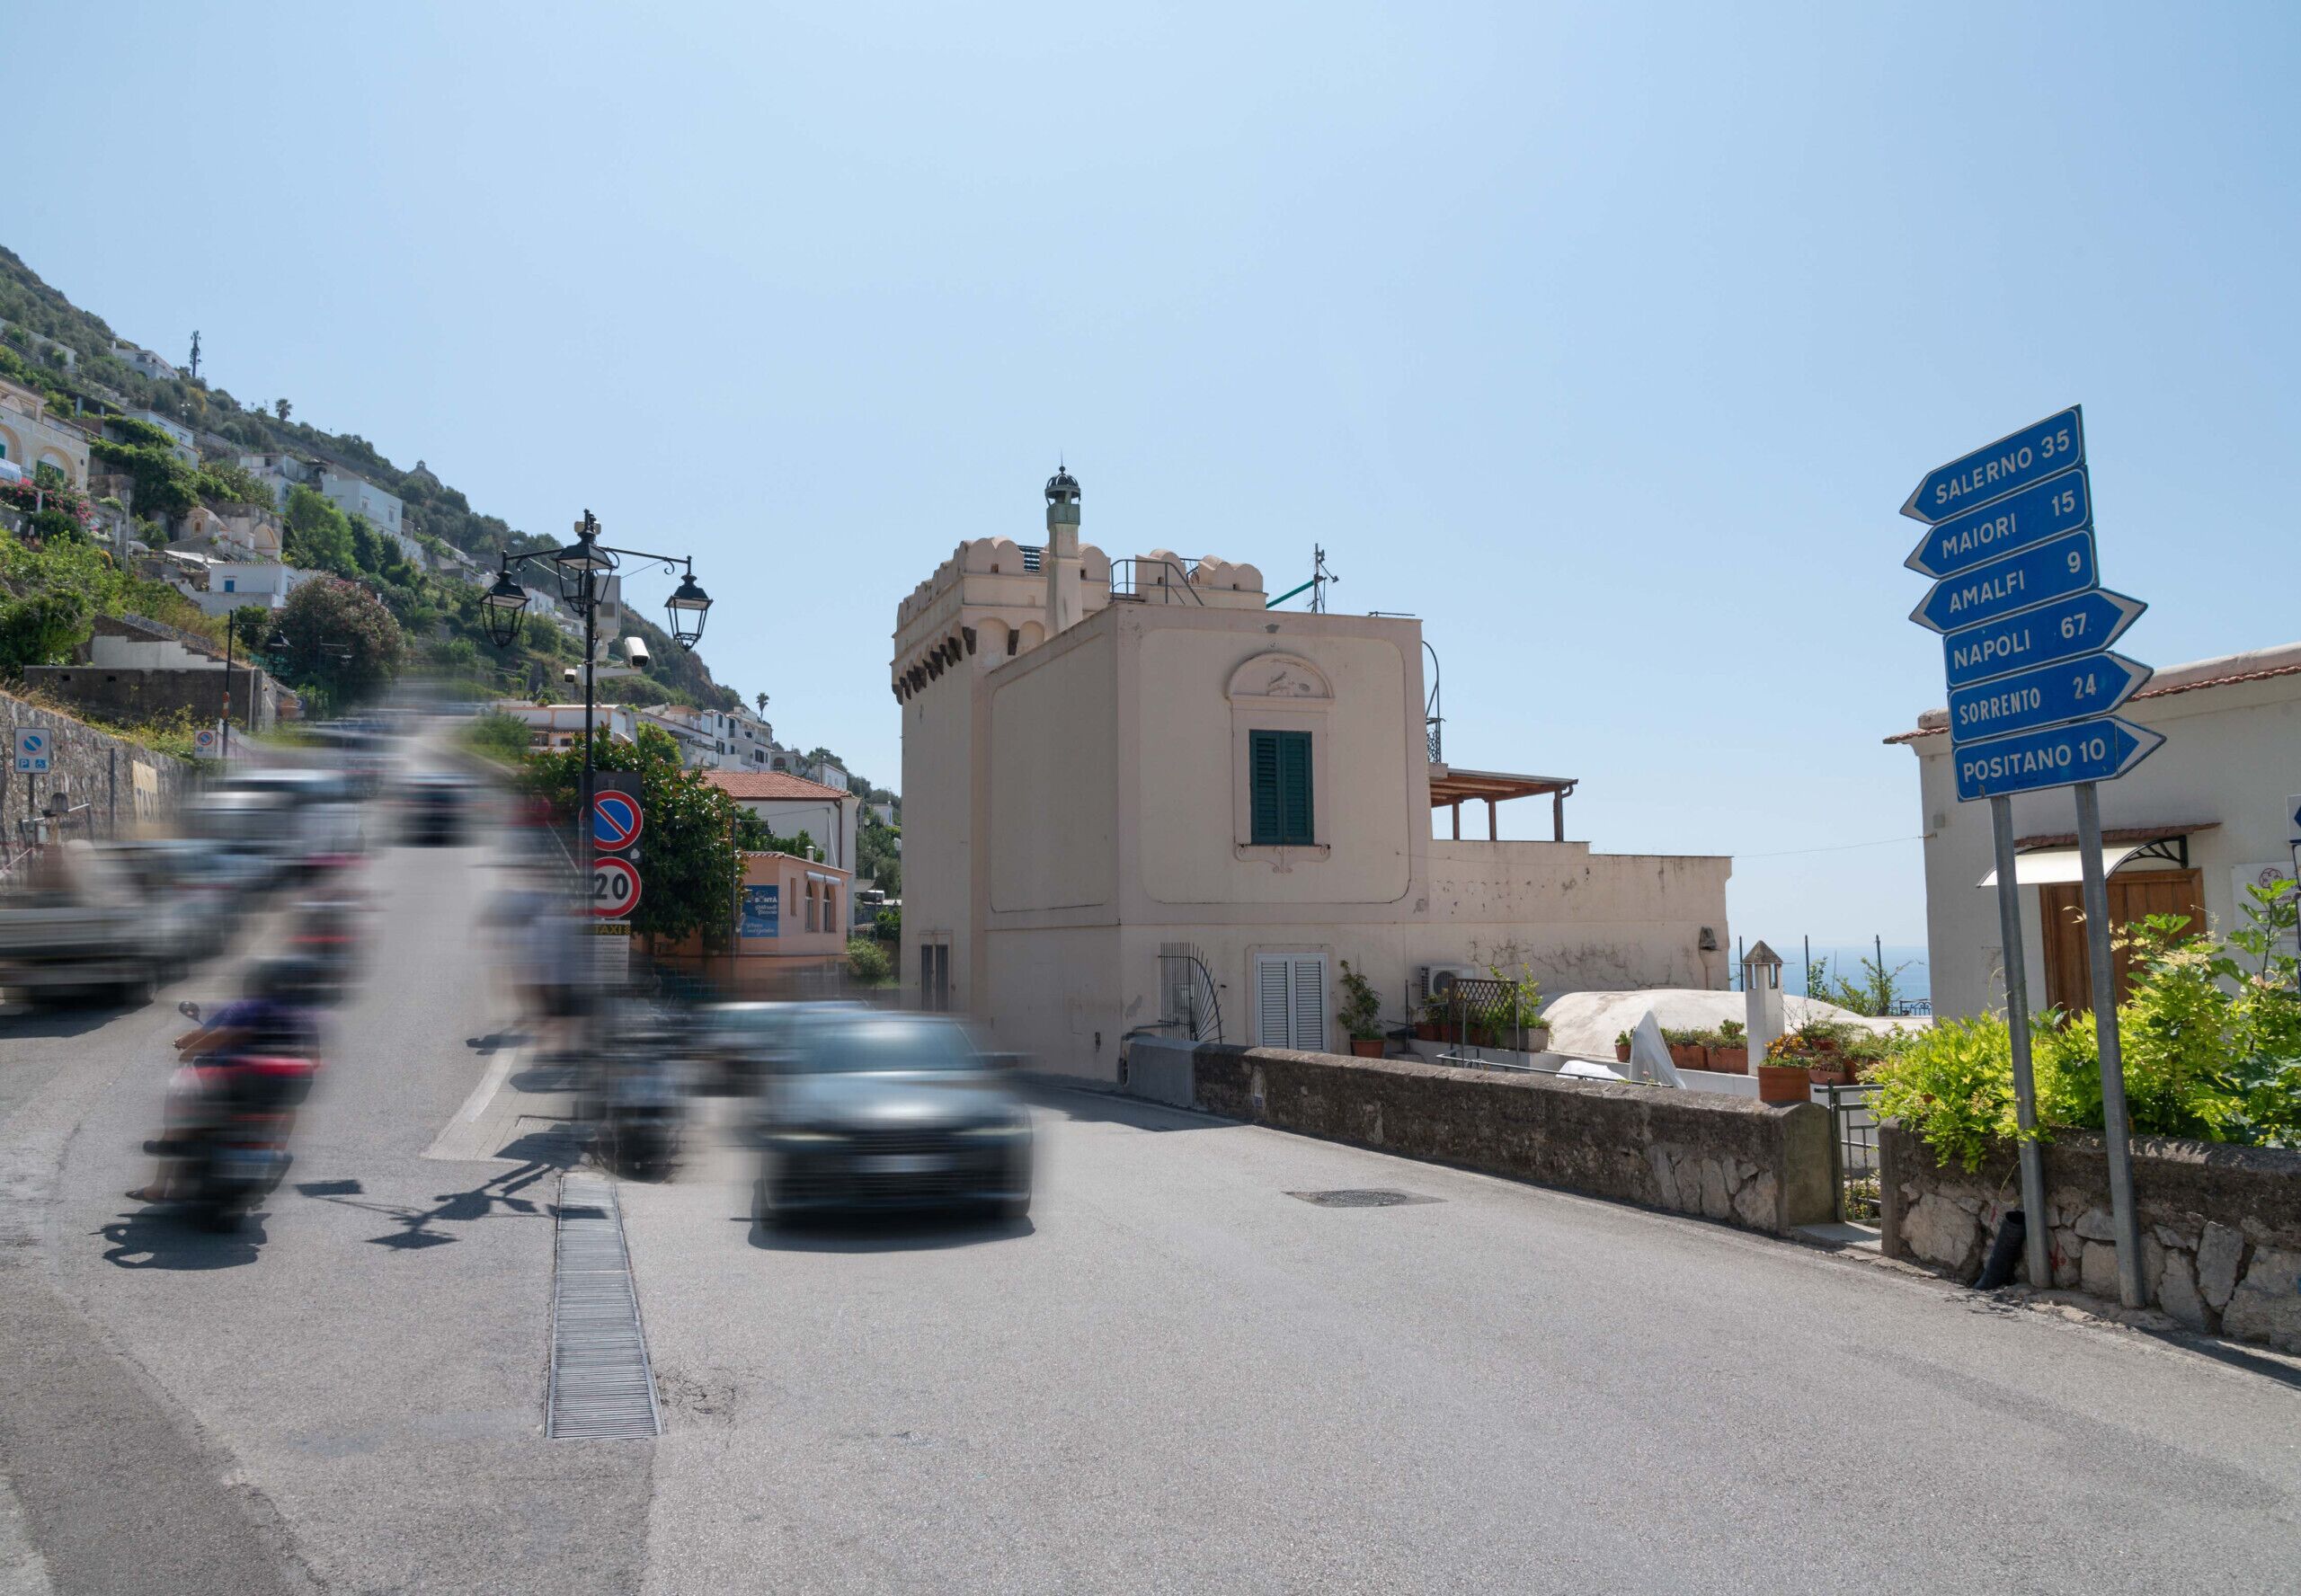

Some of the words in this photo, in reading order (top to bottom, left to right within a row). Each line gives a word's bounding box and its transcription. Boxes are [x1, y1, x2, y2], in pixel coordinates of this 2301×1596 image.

[1935, 447, 2033, 505] SALERNO
[2041, 429, 2070, 459] 35
[1942, 513, 2017, 558] MAIORI
[2051, 490, 2075, 517] 15
[1950, 570, 2025, 613] AMALFI
[2067, 551, 2081, 573] 9
[1953, 630, 2030, 669] NAPOLI
[2060, 613, 2086, 639] 67
[1959, 687, 2041, 725] SORRENTO
[2073, 673, 2097, 698] 24
[1963, 743, 2072, 783] POSITANO
[2079, 738, 2106, 763] 10
[591, 873, 629, 900] 20
[594, 925, 622, 935] TAXI
